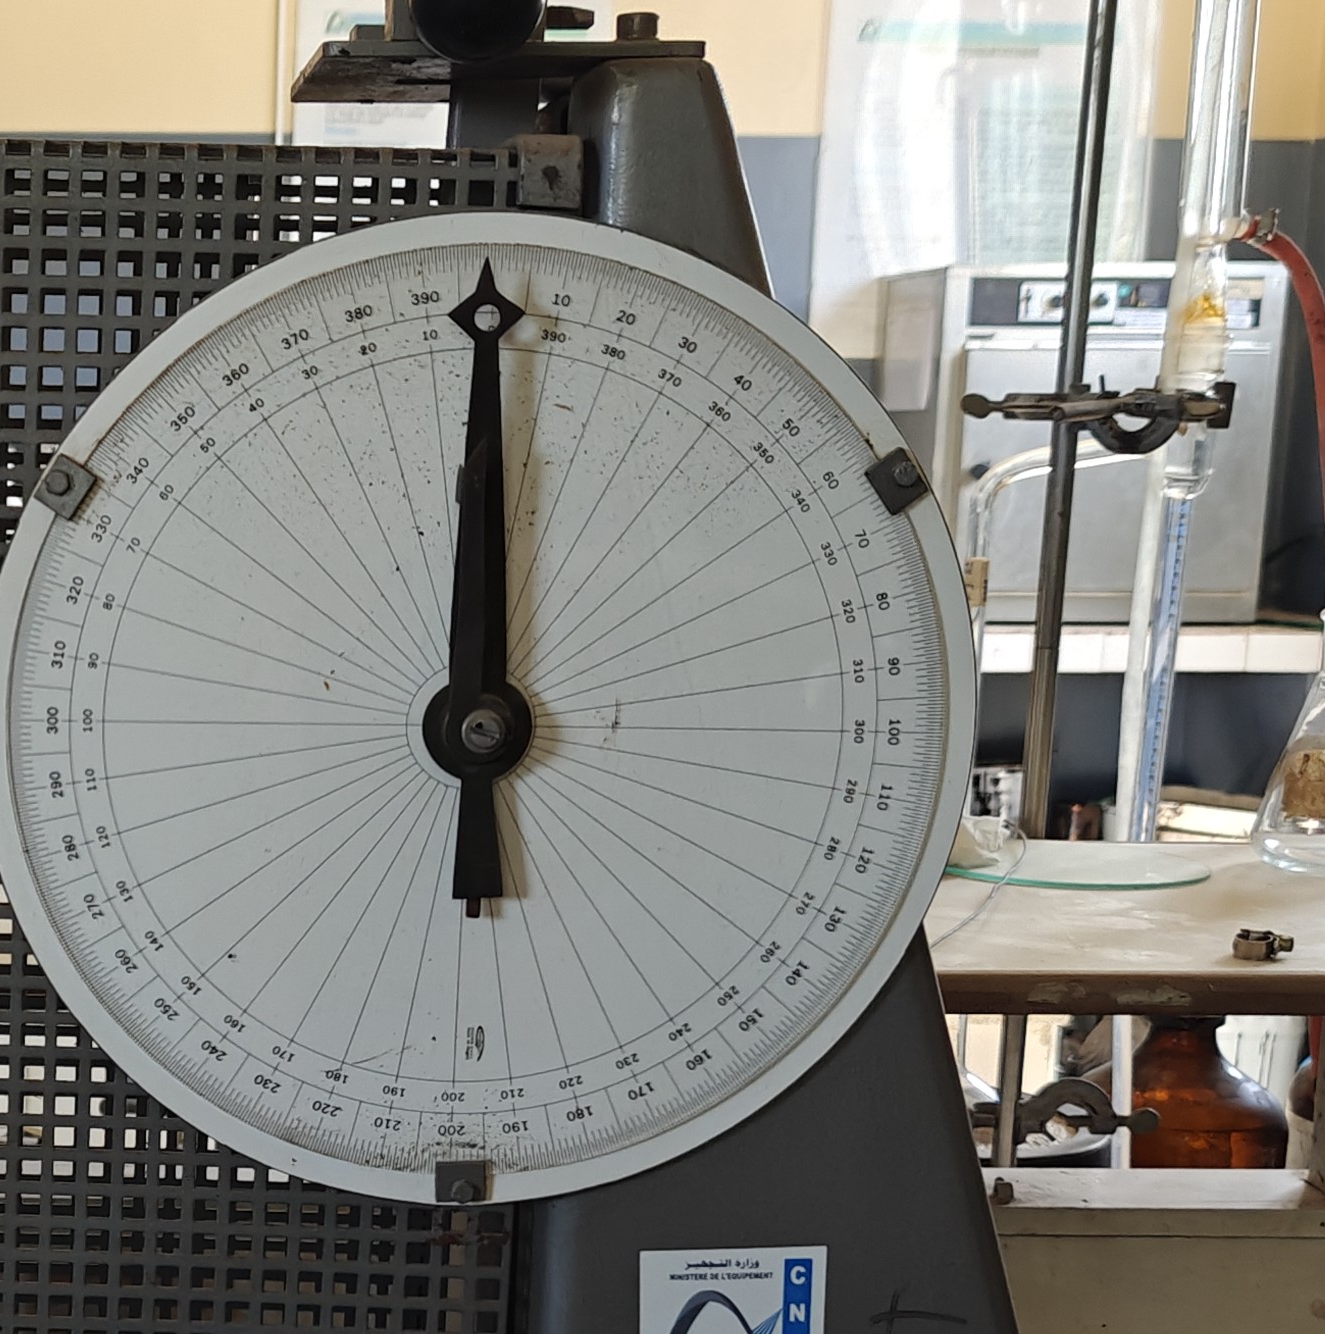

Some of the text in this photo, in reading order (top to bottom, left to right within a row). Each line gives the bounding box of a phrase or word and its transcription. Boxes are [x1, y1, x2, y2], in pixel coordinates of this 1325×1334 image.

[410, 290, 440, 306] 390
[552, 293, 571, 308] 10
[344, 304, 374, 322] 380
[616, 310, 635, 325] 20
[280, 329, 310, 350] 370
[422, 328, 439, 341] 10
[541, 328, 567, 343] 390
[359, 342, 377, 356] 20
[601, 344, 626, 361] 380
[678, 337, 698, 354] 30
[222, 363, 250, 387] 360
[301, 366, 319, 380] 30
[657, 368, 682, 388] 370
[733, 374, 752, 392] 40
[248, 398, 266, 413] 40
[708, 400, 732, 422] 360
[170, 406, 196, 433] 350
[782, 418, 800, 437] 50
[199, 437, 217, 454] 50
[752, 442, 774, 465] 350
[126, 456, 150, 485] 340
[822, 471, 839, 490] 60
[159, 484, 175, 502] 60
[791, 489, 810, 514] 340
[91, 514, 112, 543] 330
[126, 537, 141, 554] 70
[854, 530, 870, 549] 70
[820, 541, 838, 566] 330
[66, 575, 84, 605] 320
[102, 594, 115, 611] 80
[841, 599, 856, 624] 320
[875, 592, 890, 611] 80
[51, 641, 66, 670] 310
[88, 652, 99, 669] 90
[852, 659, 864, 683] 310
[887, 657, 900, 675] 90
[47, 707, 59, 734] 300
[82, 709, 93, 733] 100
[854, 720, 864, 743] 300
[888, 718, 900, 746] 100
[50, 771, 64, 798] 290
[86, 768, 97, 792] 110
[843, 778, 857, 804] 290
[877, 784, 892, 811] 110
[96, 825, 111, 848] 120
[63, 835, 79, 861] 280
[824, 836, 840, 861] 280
[855, 847, 874, 874] 120
[116, 880, 134, 903] 130
[84, 893, 105, 920] 270
[795, 892, 816, 915] 270
[824, 906, 845, 933] 130
[144, 930, 164, 952] 140
[113, 949, 139, 974] 260
[759, 941, 782, 963] 260
[785, 960, 810, 986] 140
[181, 975, 203, 996] 150
[716, 985, 739, 1006] 250
[154, 997, 180, 1021] 250
[223, 1014, 246, 1033] 160
[738, 1007, 764, 1032] 150
[668, 1023, 692, 1042] 240
[200, 1039, 228, 1061] 240
[272, 1045, 296, 1062] 170
[685, 1049, 712, 1071] 160
[616, 1053, 640, 1069] 230
[253, 1073, 281, 1093] 230
[324, 1067, 349, 1083] 180
[559, 1075, 582, 1090] 220
[382, 1084, 406, 1097] 190
[441, 1090, 465, 1102] 200
[500, 1086, 524, 1099] 210
[627, 1082, 654, 1100] 170
[312, 1099, 342, 1117] 220
[566, 1106, 593, 1122] 180
[374, 1117, 402, 1130] 210
[438, 1125, 466, 1136] 200
[502, 1120, 528, 1133] 190
